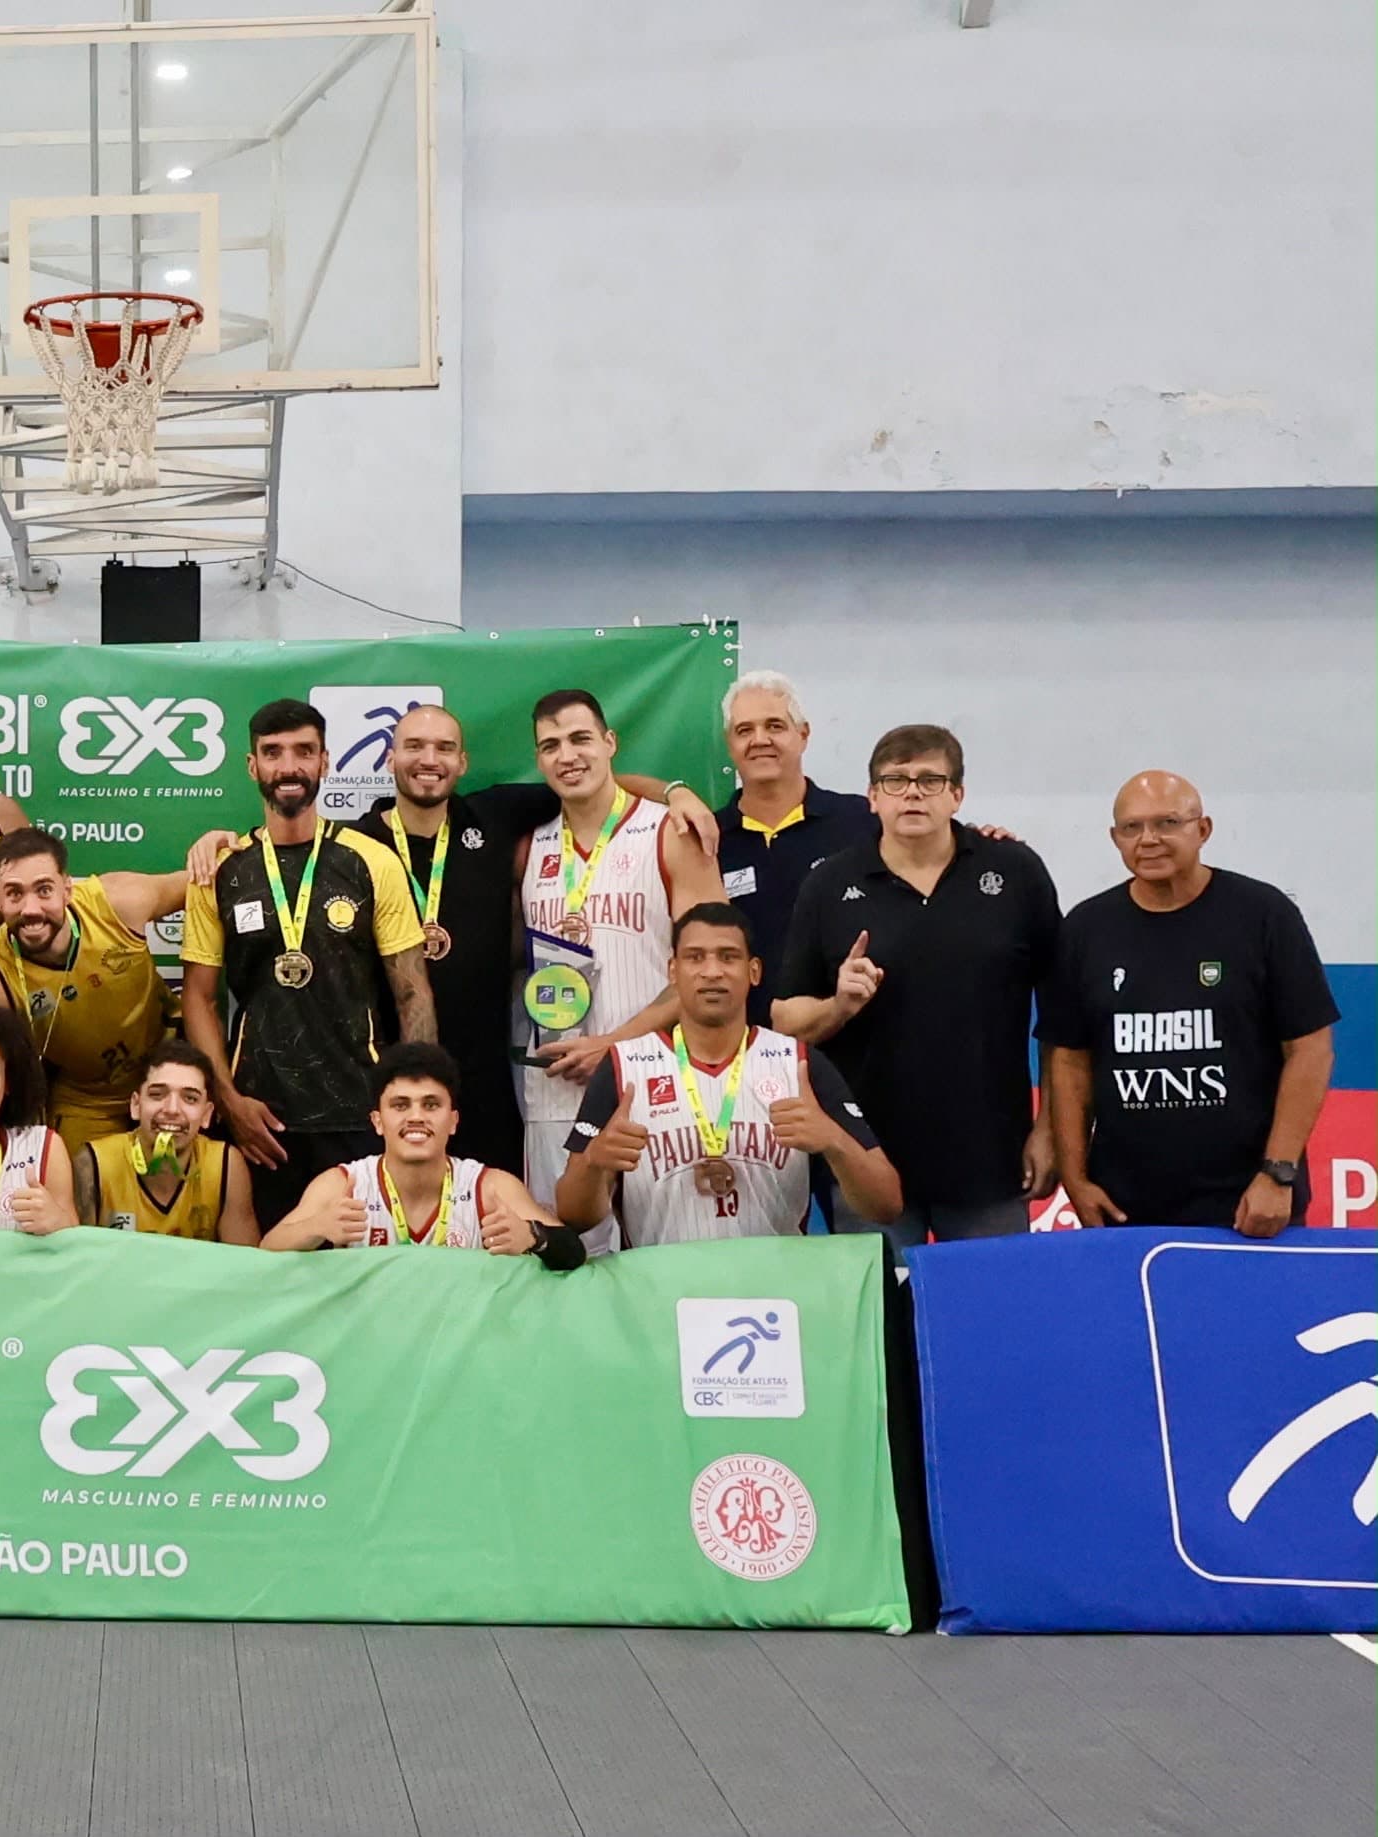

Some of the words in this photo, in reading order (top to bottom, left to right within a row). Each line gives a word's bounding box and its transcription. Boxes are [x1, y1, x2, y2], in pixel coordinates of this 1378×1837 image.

[375, 776, 385, 785] DE
[58, 787, 139, 798] MASCULINO
[143, 787, 151, 798] E
[156, 787, 224, 798] FEMININO
[324, 792, 355, 809] CBC
[72, 822, 145, 843] PAULO
[1113, 1008, 1222, 1053] BRASIL
[626, 1053, 656, 1062] vivo
[1112, 1064, 1228, 1103] WNS
[694, 1391, 724, 1407] CBC
[41, 1488, 179, 1508] MASCULINO
[189, 1492, 202, 1508] E
[211, 1492, 328, 1509] FEMININO
[61, 1542, 189, 1578] PAULO
[741, 1562, 777, 1575] 1900
